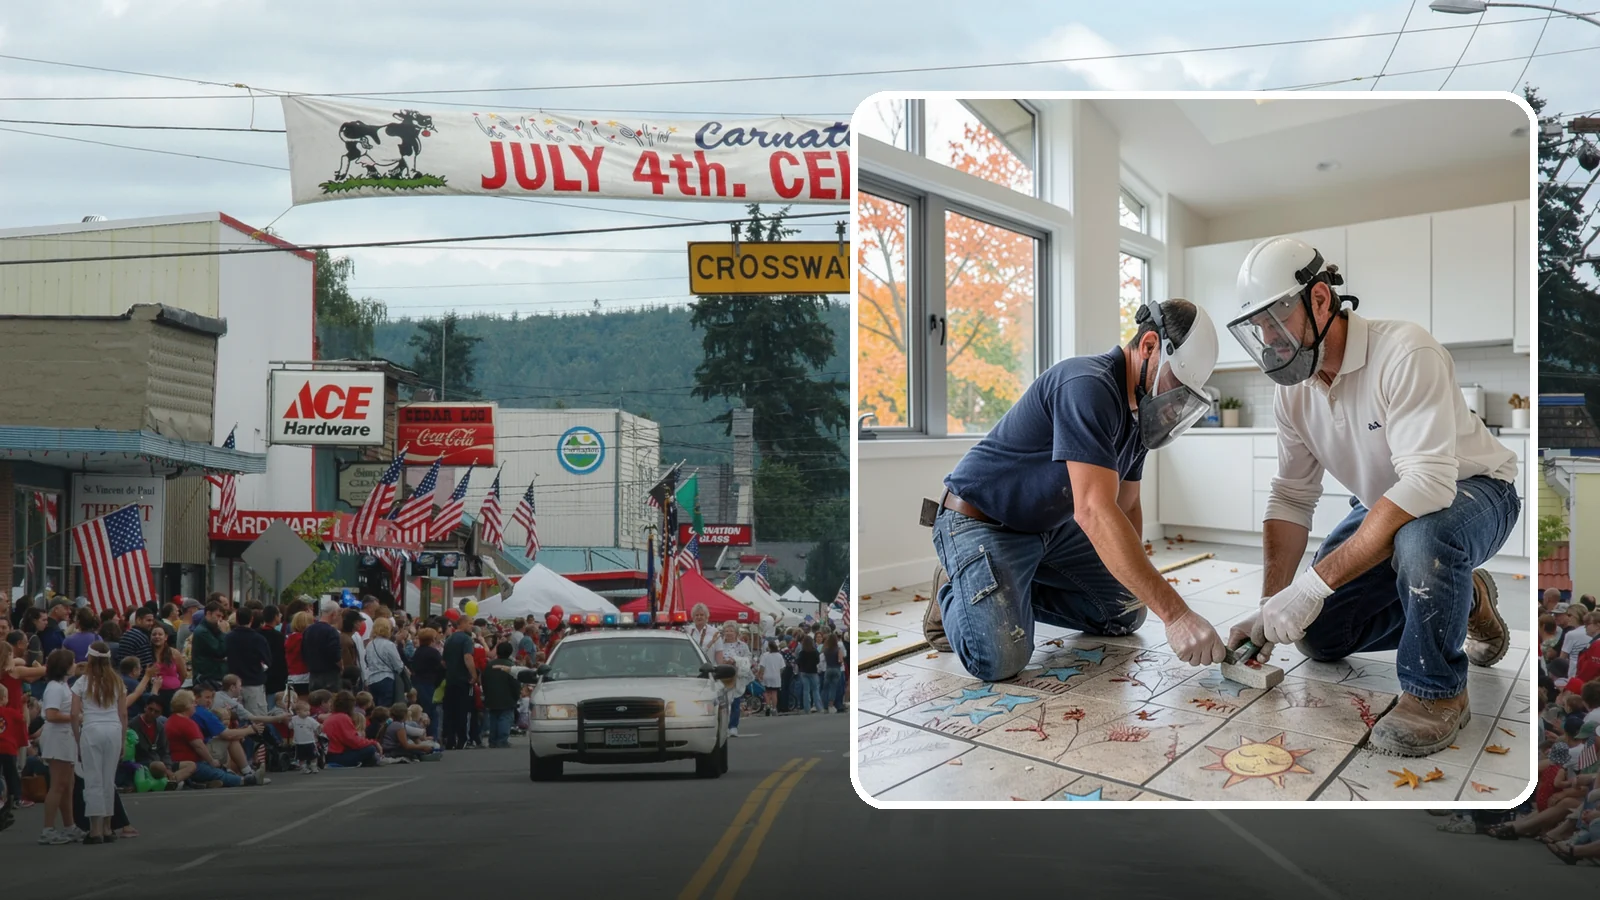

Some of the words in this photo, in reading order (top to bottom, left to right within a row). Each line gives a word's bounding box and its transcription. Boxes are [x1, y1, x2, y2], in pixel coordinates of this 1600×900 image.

[481, 141, 605, 192] JULY
[632, 150, 747, 197] 4th.
[697, 254, 850, 280] CROSSWA
[283, 380, 373, 420] ACE
[283, 421, 371, 436] Hardware
[416, 428, 477, 447] Coca-Cola
[83, 485, 93, 494] St.
[95, 485, 124, 495] Vincent
[126, 486, 136, 495] de
[137, 485, 155, 496] Paul
[688, 526, 741, 535] CRNATION
[699, 535, 730, 544] GLASS
